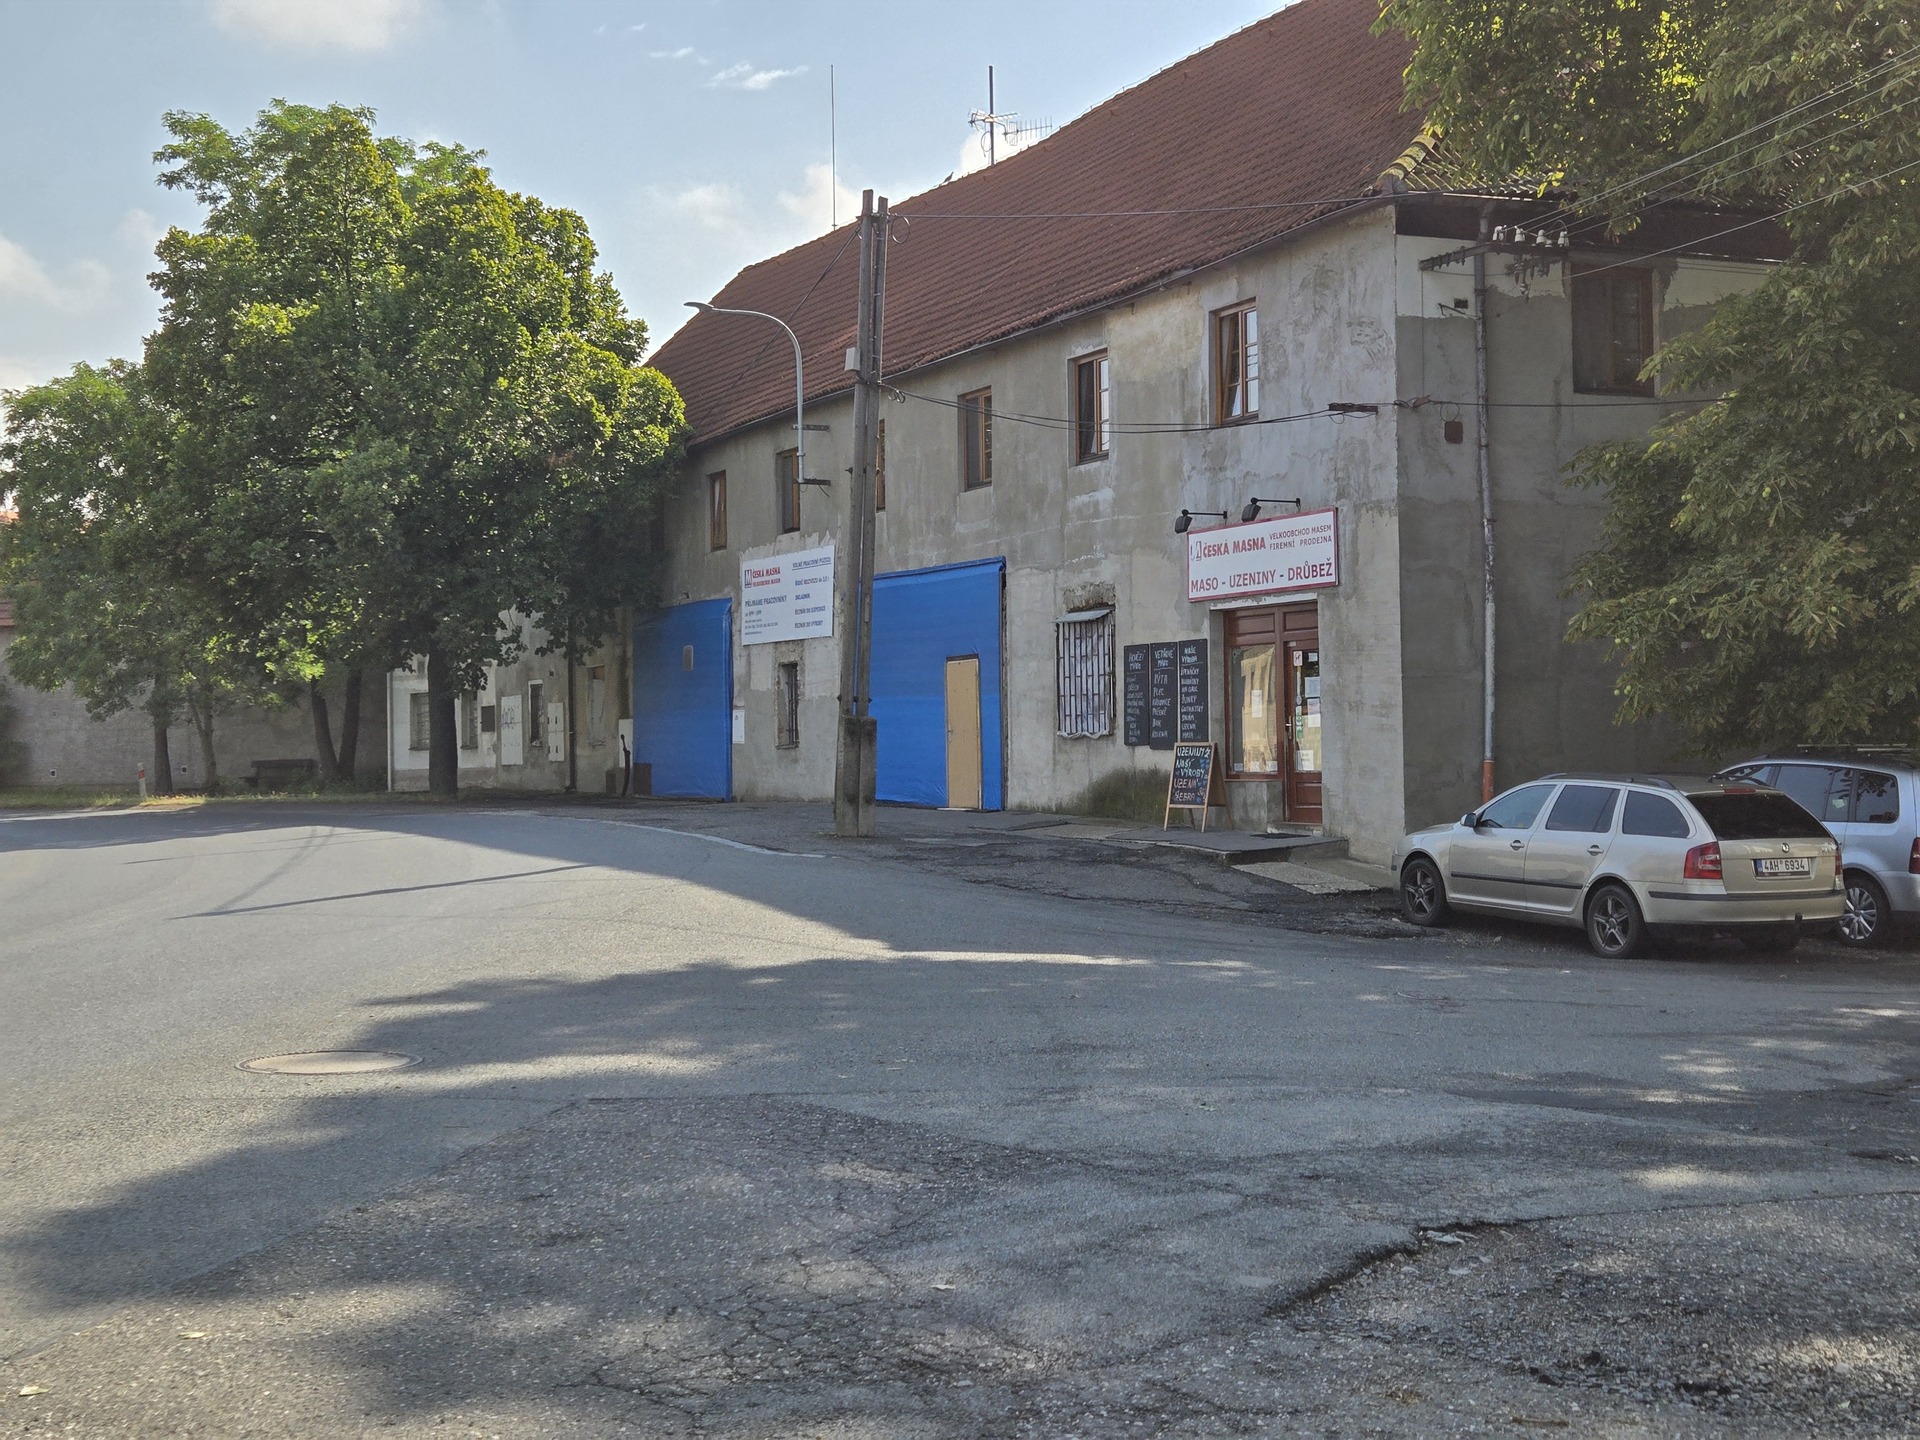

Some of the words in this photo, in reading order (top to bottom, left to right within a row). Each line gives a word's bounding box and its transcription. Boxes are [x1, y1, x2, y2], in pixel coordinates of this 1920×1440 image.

[1269, 527, 1310, 540] VELKOOBCHOD
[1311, 524, 1332, 534] MASEM
[1203, 539, 1229, 558] ČESKÁ
[1233, 537, 1266, 554] MASNA
[1270, 538, 1295, 550] FIREMNÍ
[1300, 536, 1332, 546] PRODEJNA
[753, 568, 765, 578] ČESKÁ
[766, 567, 780, 576] MASNA
[1191, 577, 1218, 593] MASO
[1229, 570, 1276, 588] UZENINY
[1288, 558, 1333, 581] DRŮBEŽ
[1177, 747, 1204, 757] UZENINY
[1180, 768, 1205, 779] VÝROBY
[1764, 860, 1779, 871] 4AH
[1785, 859, 1805, 870] 6934
